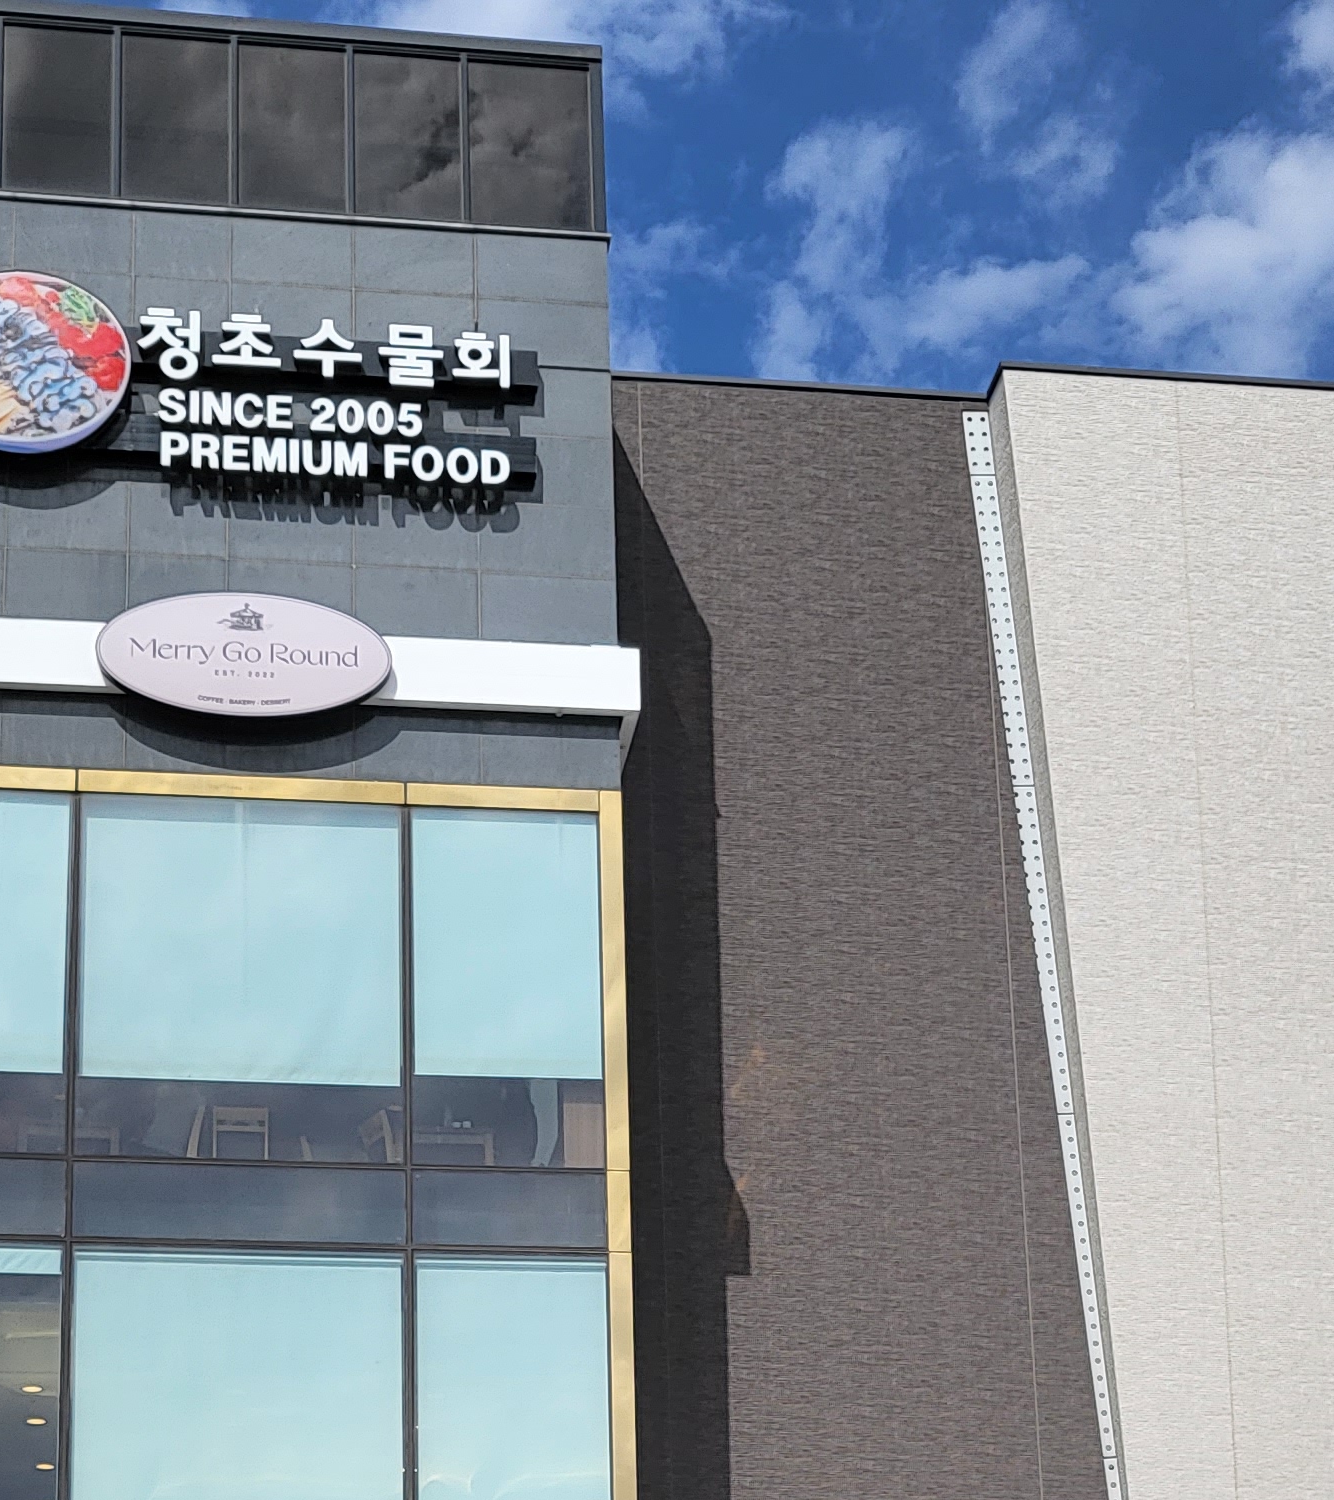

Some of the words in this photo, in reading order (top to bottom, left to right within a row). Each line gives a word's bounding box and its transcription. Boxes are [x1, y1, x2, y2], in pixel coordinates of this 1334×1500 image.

[136, 307, 511, 390] 청초수물회
[158, 387, 295, 430] SINCE
[309, 397, 423, 438] 2005
[159, 431, 368, 478] PREMIUM
[384, 444, 511, 486] FOOD
[128, 637, 216, 665] Merry
[222, 641, 262, 663] Go
[269, 642, 360, 668] Round
[197, 694, 224, 704] COFFEE
[228, 698, 256, 706] BAKERY
